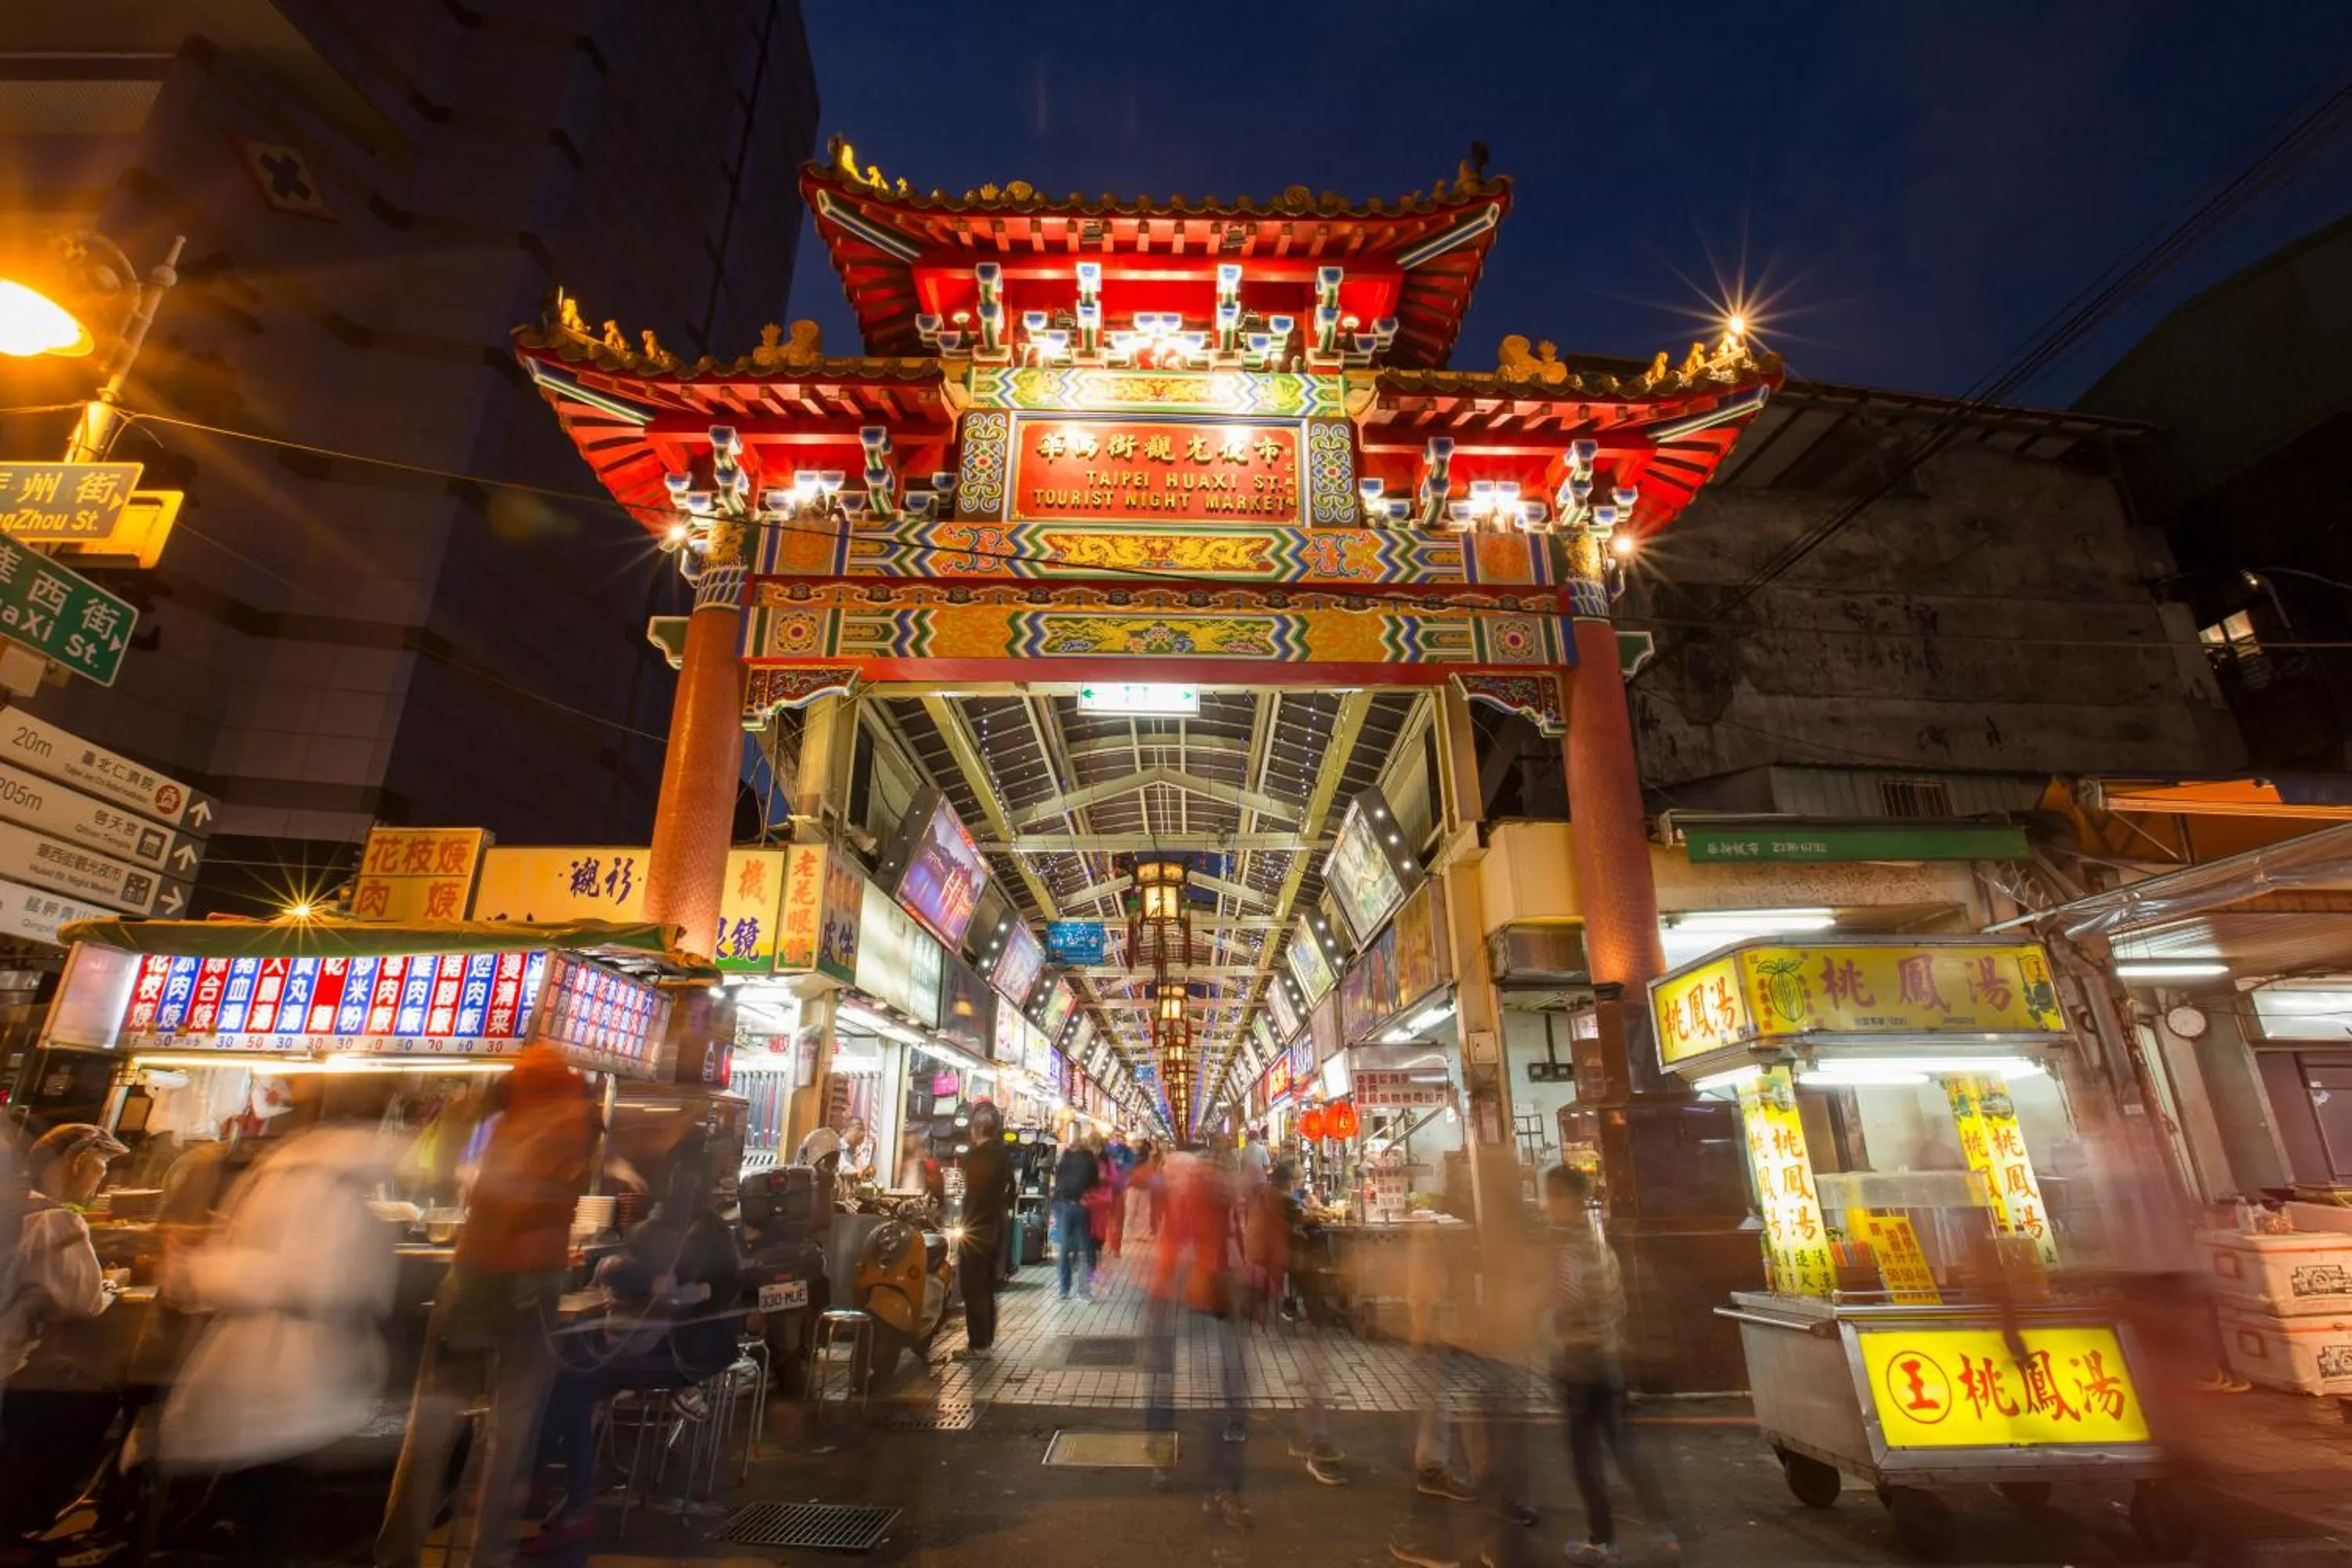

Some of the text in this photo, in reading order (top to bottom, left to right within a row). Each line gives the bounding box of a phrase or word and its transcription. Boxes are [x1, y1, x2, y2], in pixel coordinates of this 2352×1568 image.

[1036, 432, 1283, 470] 華西街觀光夜市
[1087, 470, 1283, 494] TAIPEI HUAXI ST.
[1033, 488, 1287, 517] TOURIST NIGHT MARKET
[0, 508, 99, 533] gZhou St.
[0, 598, 100, 668] aXi St.
[12, 726, 53, 758] 20m
[569, 856, 634, 905] 襯衫
[1819, 953, 2013, 1014] 桃鳳湯
[1663, 975, 1737, 1048] 桃鳳湯
[216, 1036, 234, 1048] 30
[276, 1036, 292, 1049] 30
[486, 1040, 503, 1053] 30
[1772, 1128, 1817, 1241] 桃鳳湯
[1957, 1348, 2125, 1422] 桃鳳湯
